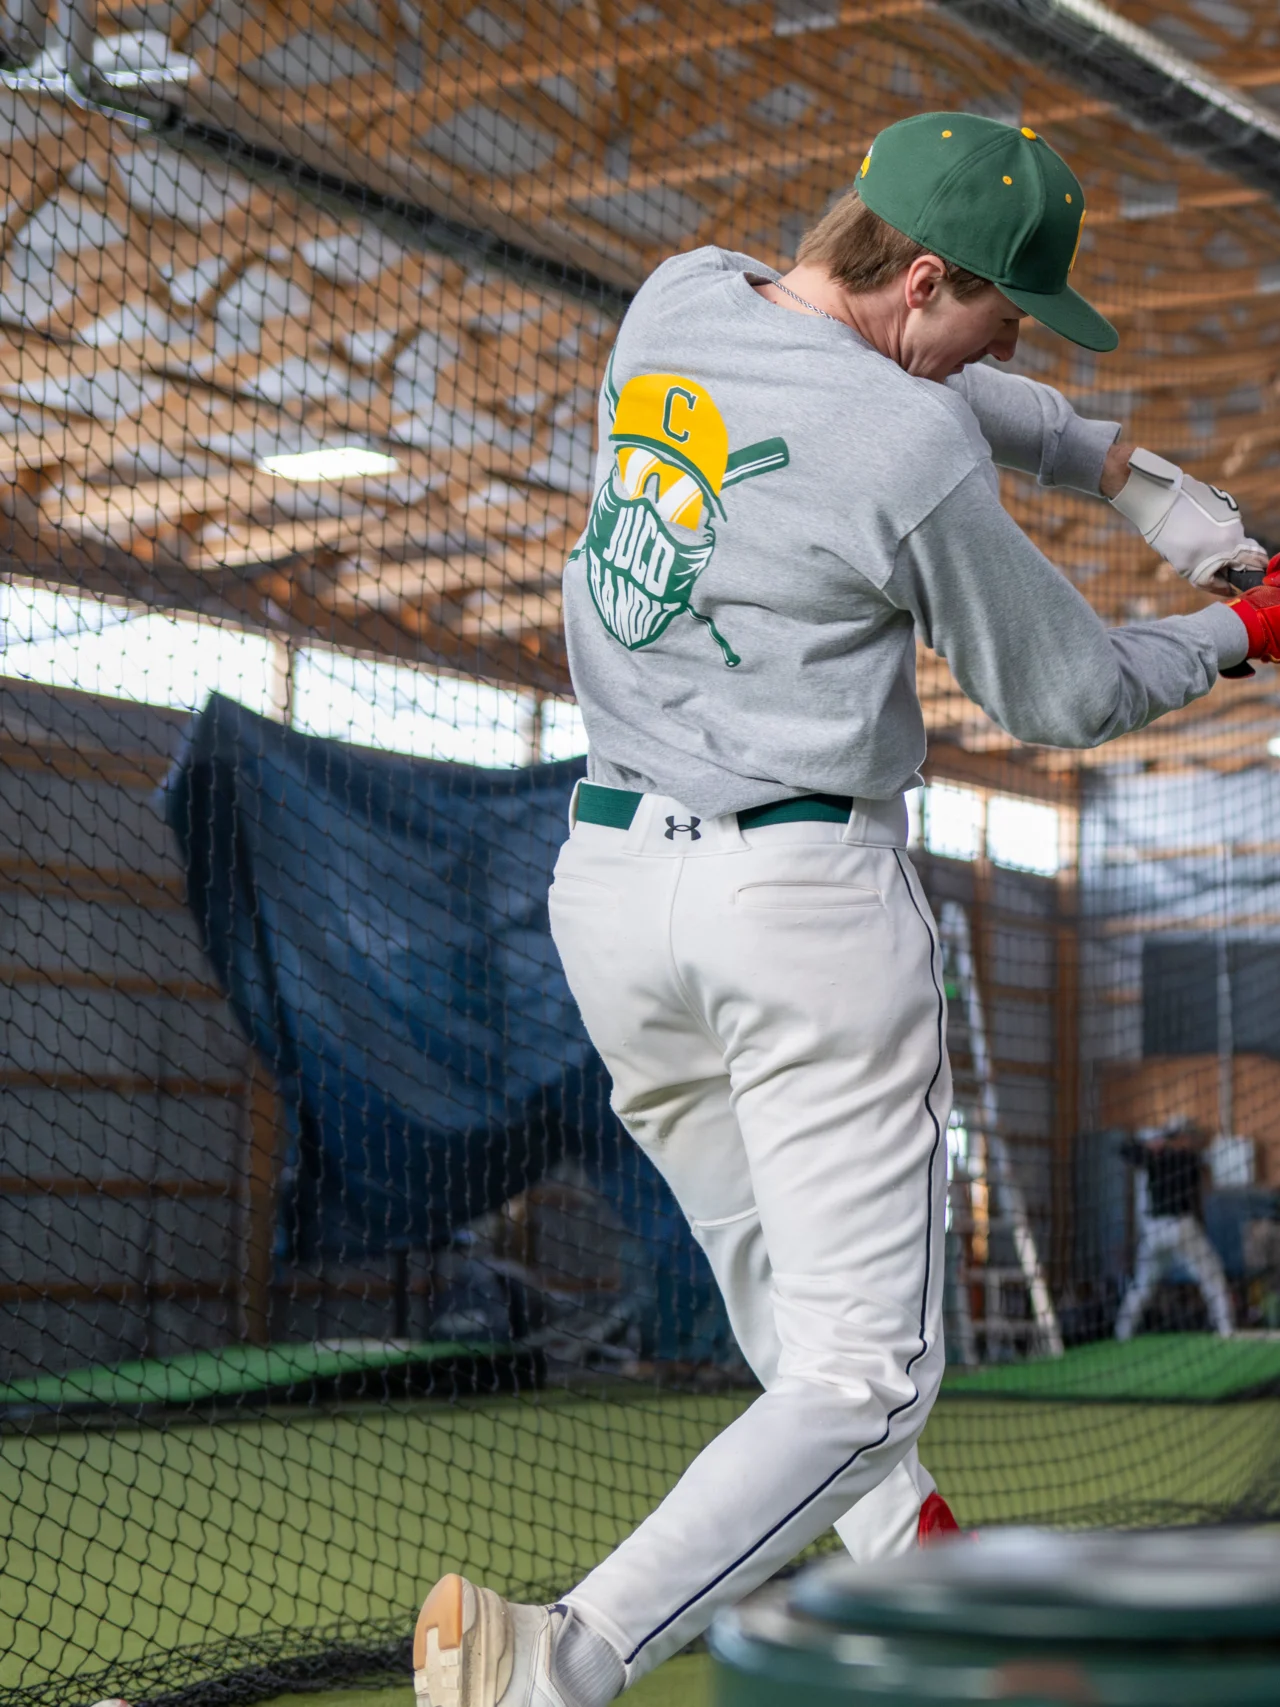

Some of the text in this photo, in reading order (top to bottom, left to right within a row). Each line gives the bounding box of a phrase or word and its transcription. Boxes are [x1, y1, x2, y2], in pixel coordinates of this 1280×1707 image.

[662, 386, 697, 443] C
[589, 547, 682, 647] BANDIT
[602, 505, 676, 597] JUCO
